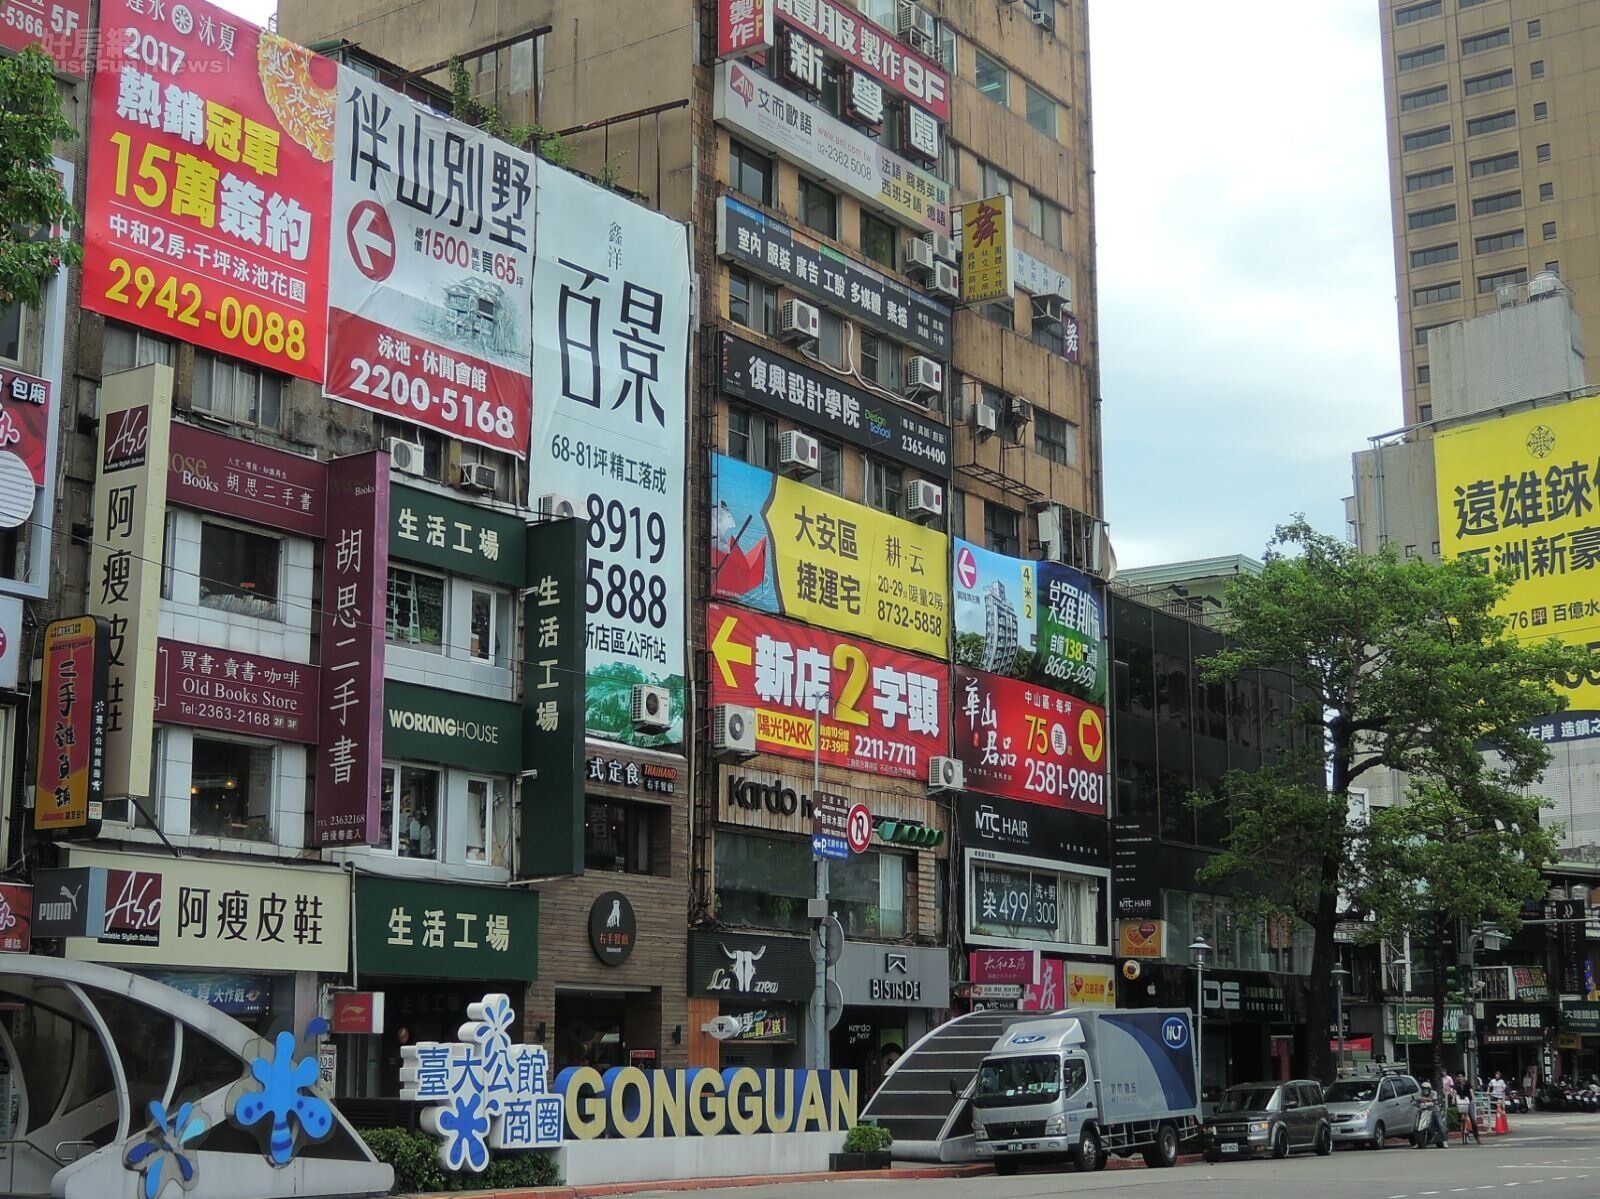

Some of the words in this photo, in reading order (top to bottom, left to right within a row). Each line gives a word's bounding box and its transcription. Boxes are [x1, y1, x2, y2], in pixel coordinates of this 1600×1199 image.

[50, 5, 79, 37] 5F
[124, 28, 185, 76] 2017
[116, 66, 280, 177] 熱銷冠軍
[345, 86, 532, 254] 伴山別墅
[109, 131, 312, 260] 15萬簽約
[607, 220, 623, 271] 鑫洋
[737, 226, 761, 258] 室內
[767, 241, 791, 274] 服裝
[796, 255, 819, 286] 廣告
[823, 268, 846, 299] 工設
[105, 258, 305, 361] 2942-0088
[558, 258, 666, 429] 百景
[12, 377, 47, 404] 包廂
[350, 358, 515, 440] 2200-5168
[748, 355, 861, 429] 復興設計學院
[551, 434, 667, 495] 68-81坪精工落成
[901, 435, 946, 466] 2365-4400
[182, 470, 219, 493] Books
[226, 472, 313, 511] 胡思二手書
[1454, 456, 1600, 540] 遠雄錸
[398, 507, 500, 562] 生活工場
[587, 493, 666, 564] 8919
[794, 505, 859, 561] 大安區
[586, 558, 667, 629] 5888
[797, 560, 861, 615] 捷運宅
[878, 599, 942, 637] 8732-5858
[329, 528, 363, 785] 胡思二手書
[535, 575, 561, 733] 生活工場
[182, 677, 209, 697] Old
[214, 683, 258, 705] Books
[262, 691, 298, 711] Store
[754, 634, 940, 737] 新店2字頭
[180, 702, 271, 727] Tel:2363-2168
[273, 717, 284, 728] 2F
[287, 719, 298, 730] 3F
[388, 708, 499, 744] WORKINGHOUSE
[757, 714, 813, 747] 陽光PARK
[854, 735, 916, 766] 2211-7711
[728, 774, 798, 816] Kardo
[1024, 758, 1104, 805] 2581-9881
[330, 814, 366, 826] 23632168
[975, 811, 1000, 833] MTC
[1002, 818, 1029, 838] HAIR
[38, 902, 72, 921] PUMA
[177, 886, 323, 945] 阿瘦皮鞋
[1035, 901, 1056, 924] 300
[1134, 899, 1152, 908] HAIR
[387, 906, 510, 952] 生活工場
[872, 979, 921, 1000] BISINDE
[1495, 1013, 1541, 1028] 大陸眼鏡
[417, 1046, 547, 1097] 臺大公館
[503, 1098, 562, 1144] 商圈
[562, 1067, 858, 1141] GONGGUAN
